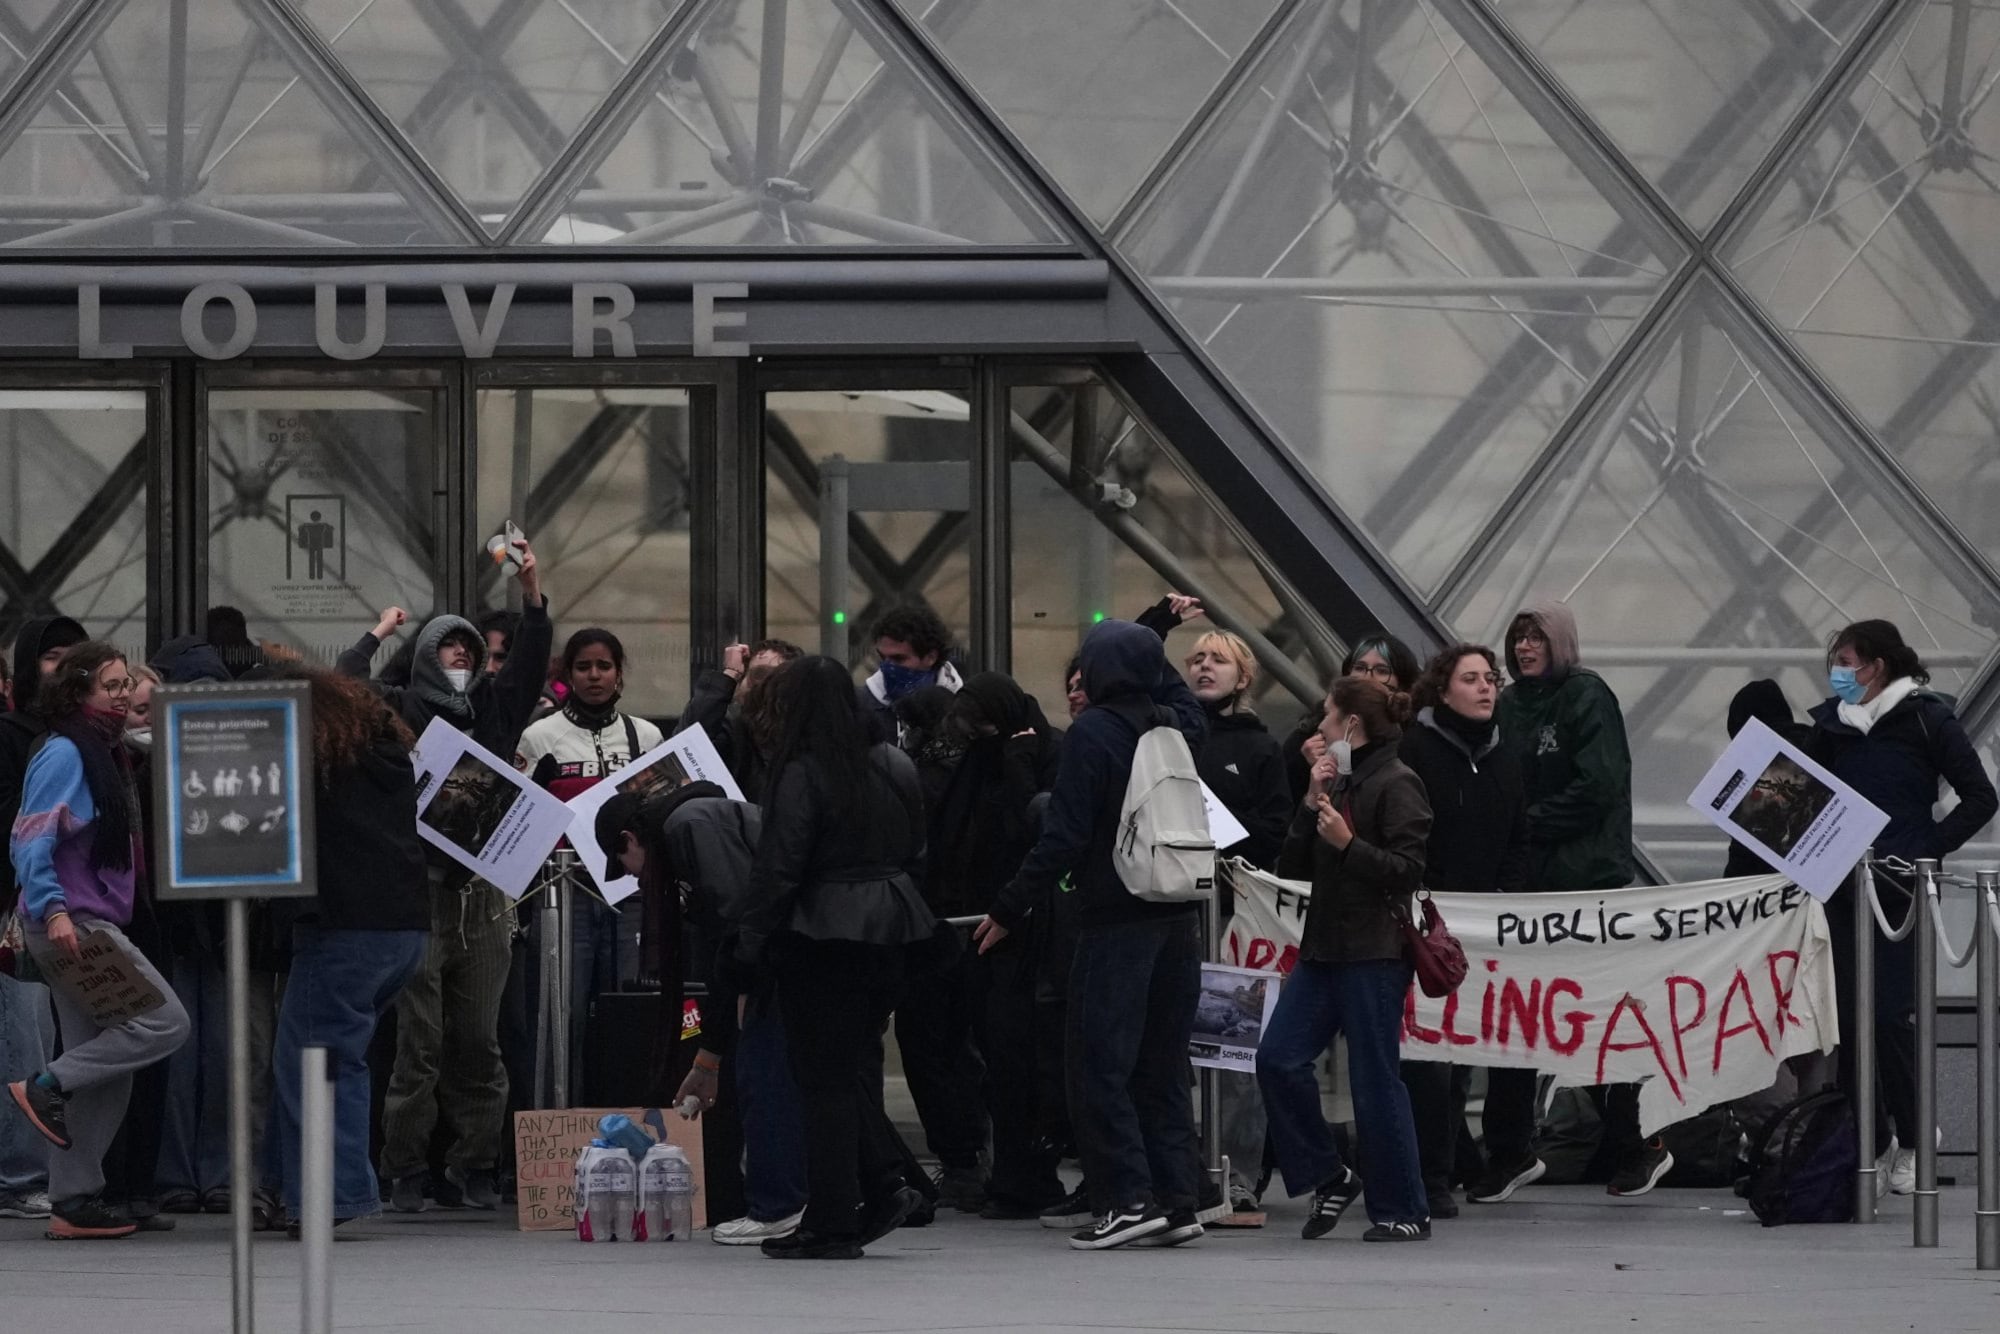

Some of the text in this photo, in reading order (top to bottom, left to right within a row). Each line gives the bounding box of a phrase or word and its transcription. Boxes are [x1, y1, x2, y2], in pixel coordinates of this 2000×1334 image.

[78, 281, 750, 361] LOUVRE
[1650, 884, 1809, 942] SERVICE
[682, 1008, 702, 1028] gt
[1222, 1050, 1253, 1061] SOMBRE
[520, 1135, 561, 1149] THAT
[520, 1146, 583, 1161] DEGRA
[520, 1162, 574, 1181] CULTU
[520, 1186, 548, 1202] THE
[528, 1204, 548, 1220] TO
